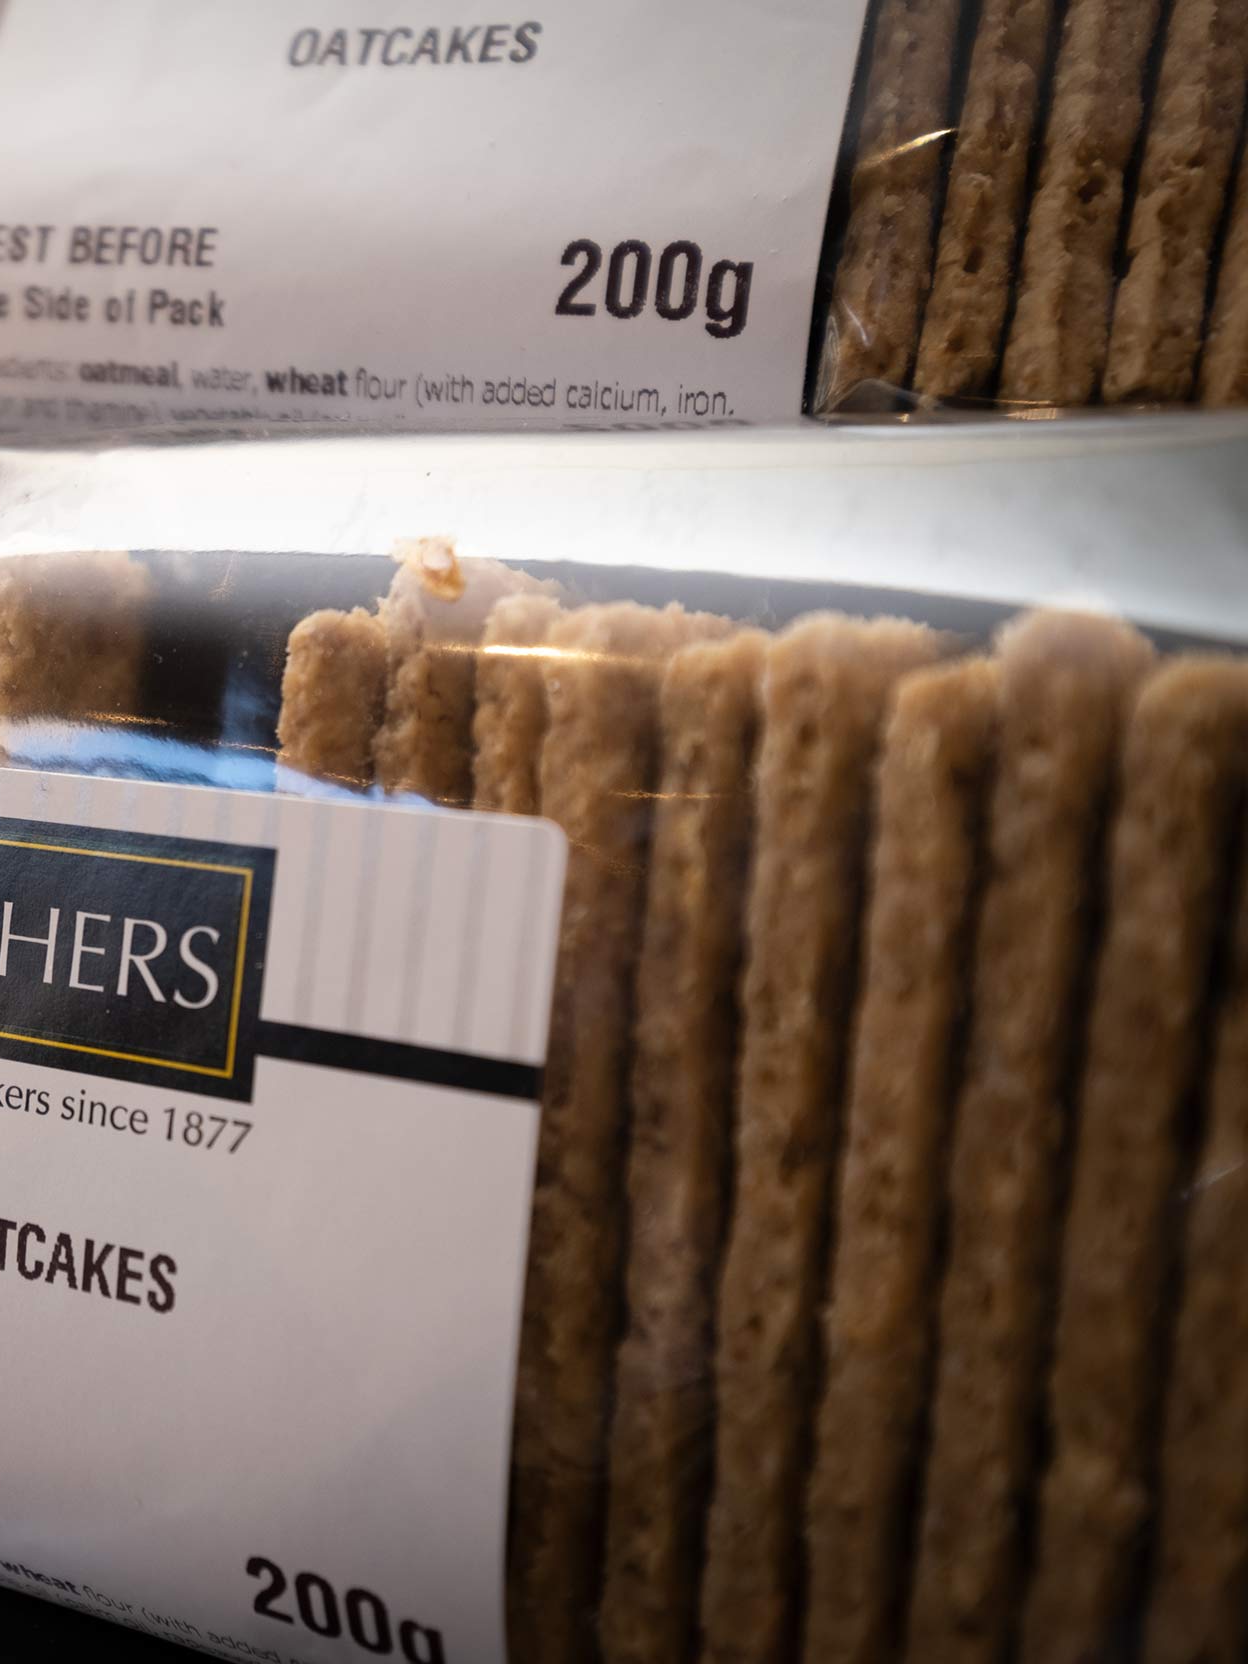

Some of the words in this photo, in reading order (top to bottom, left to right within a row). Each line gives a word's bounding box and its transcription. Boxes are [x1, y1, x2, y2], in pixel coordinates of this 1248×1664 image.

[288, 21, 543, 67] OATCAKES
[68, 226, 219, 268] BEFORE
[23, 285, 90, 323] Side
[105, 288, 136, 325] of
[148, 288, 227, 328] Pack
[555, 238, 755, 340] 200g
[265, 367, 349, 397] wheat
[355, 367, 408, 402] flour
[415, 371, 475, 408] (with
[481, 376, 556, 408] added
[566, 380, 667, 417] calcium,
[60, 1088, 150, 1136] since
[163, 1107, 254, 1155] 1877
